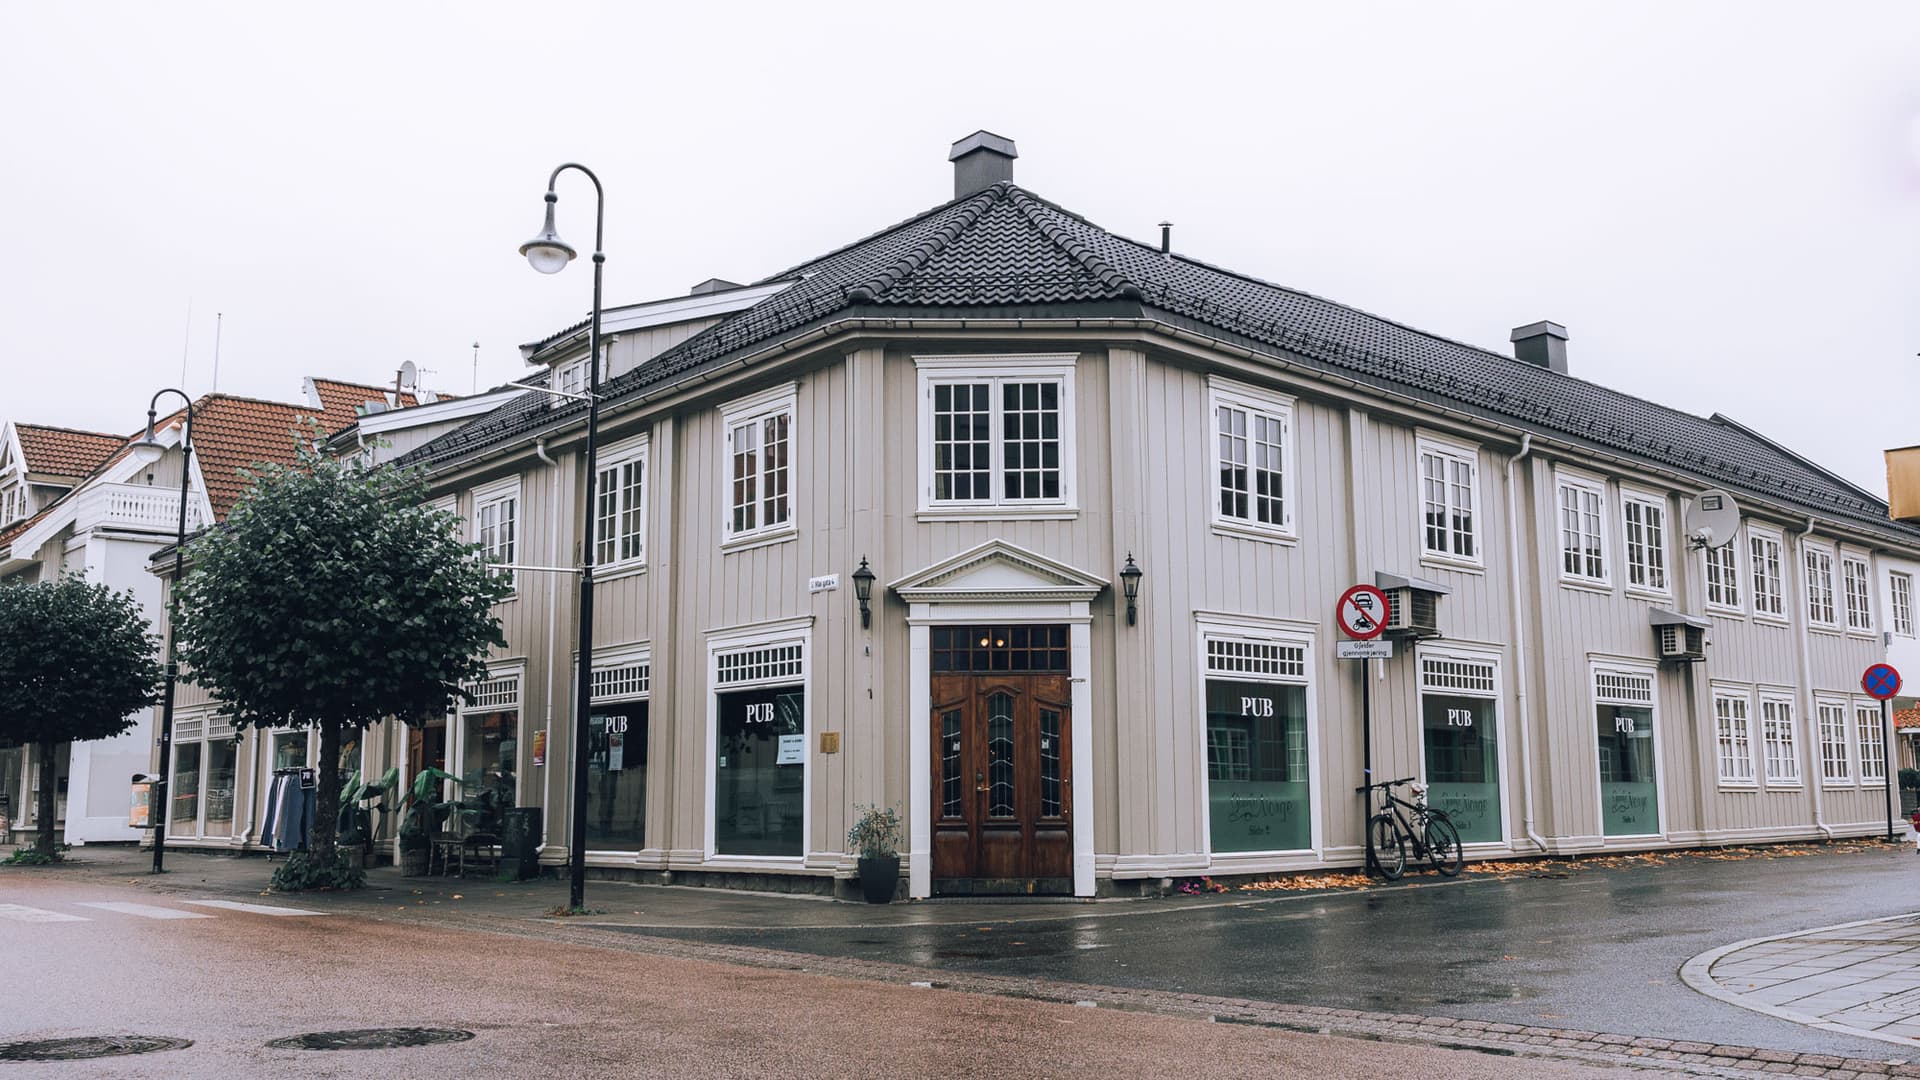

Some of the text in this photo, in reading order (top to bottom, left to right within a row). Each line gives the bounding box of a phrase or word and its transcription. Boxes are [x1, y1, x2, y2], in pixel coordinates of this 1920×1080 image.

[745, 702, 774, 723] PUB
[1240, 696, 1273, 717] PUB
[605, 716, 628, 734] PUB
[1447, 709, 1472, 726] PUB
[1615, 717, 1634, 732] PUB
